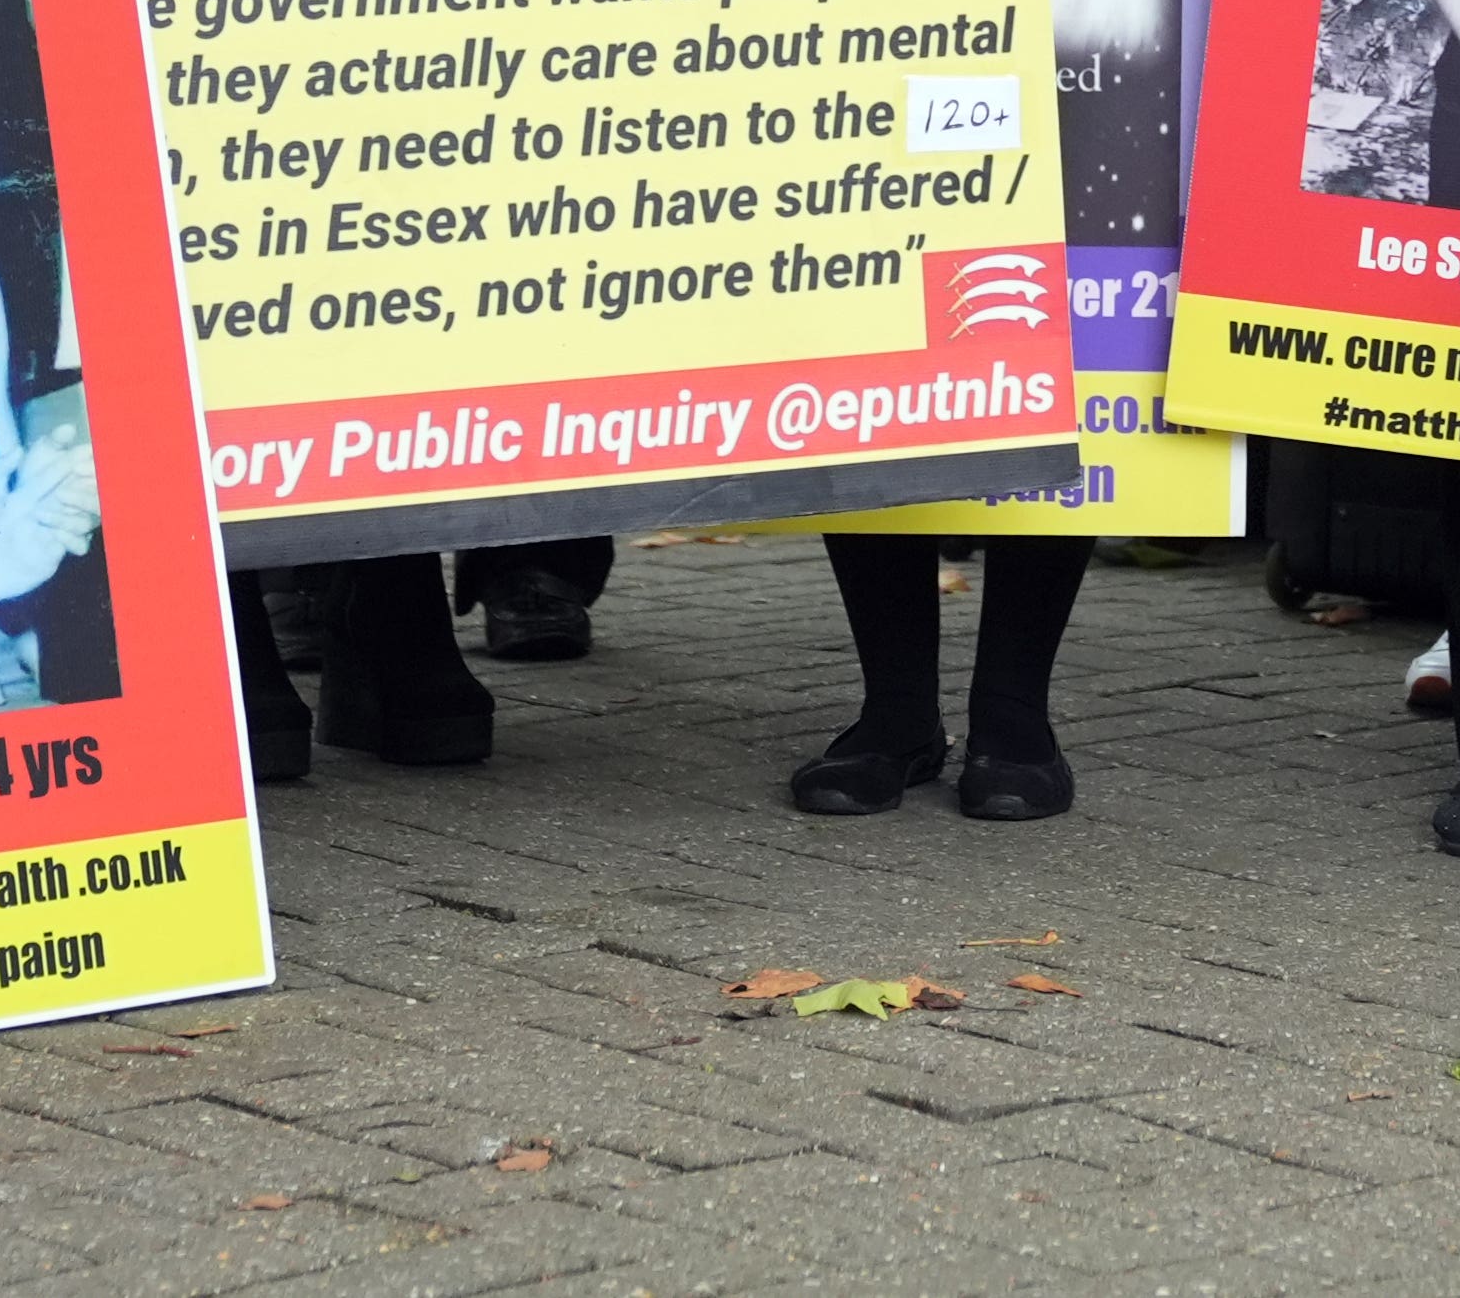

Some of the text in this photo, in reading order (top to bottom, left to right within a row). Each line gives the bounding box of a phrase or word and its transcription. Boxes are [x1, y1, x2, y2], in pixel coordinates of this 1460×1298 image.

[166, 5, 1016, 115] they actually care about mental
[220, 90, 895, 190] they need to listen to the
[920, 95, 1014, 136] 120+
[258, 206, 308, 258] in
[326, 201, 490, 252] Essex
[507, 184, 616, 238] who
[632, 178, 758, 229] have
[774, 154, 994, 218] suffered
[1357, 226, 1428, 276] Lee
[309, 285, 455, 333] ones,
[476, 267, 567, 318] not
[582, 259, 754, 321] ignore
[329, 363, 1055, 478] Public Inquiry @eputnhs
[21, 735, 103, 799] yrs
